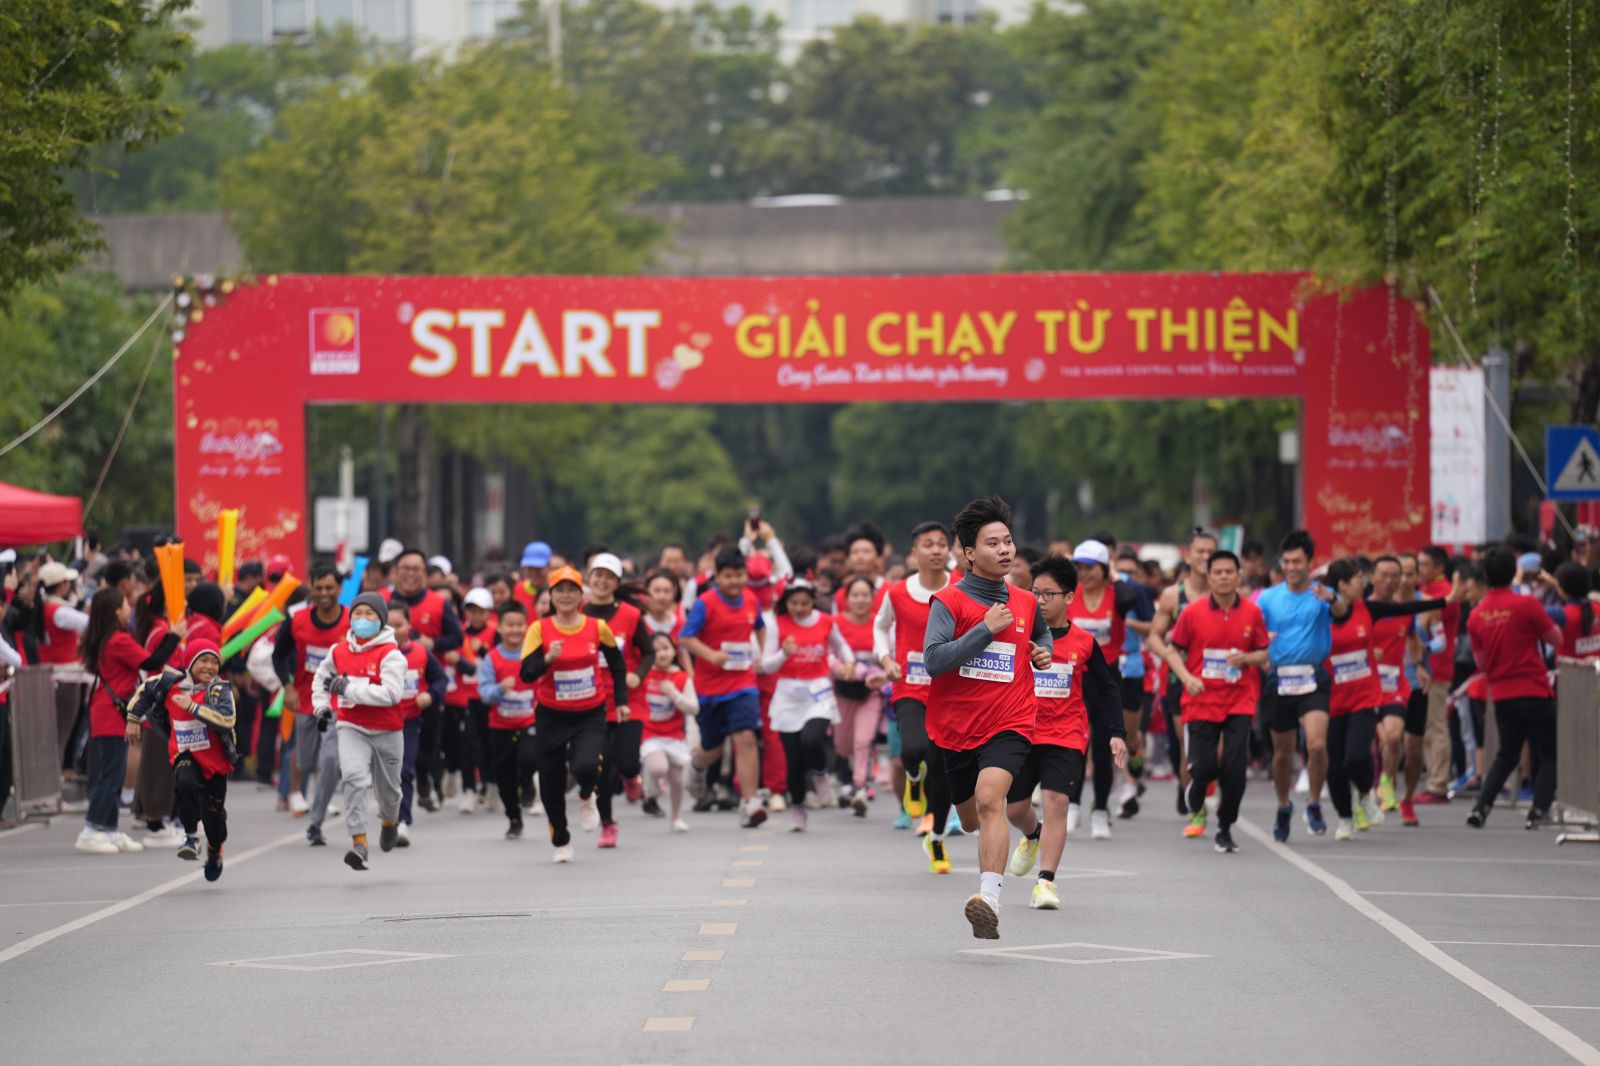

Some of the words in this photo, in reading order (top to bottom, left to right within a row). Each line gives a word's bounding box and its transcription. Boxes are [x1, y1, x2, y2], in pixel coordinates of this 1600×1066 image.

[409, 307, 662, 378] START
[735, 298, 848, 359] GIẢI
[866, 310, 1018, 363] CHẠY
[1034, 299, 1112, 354] TỪ
[1126, 295, 1299, 362] THIỆN
